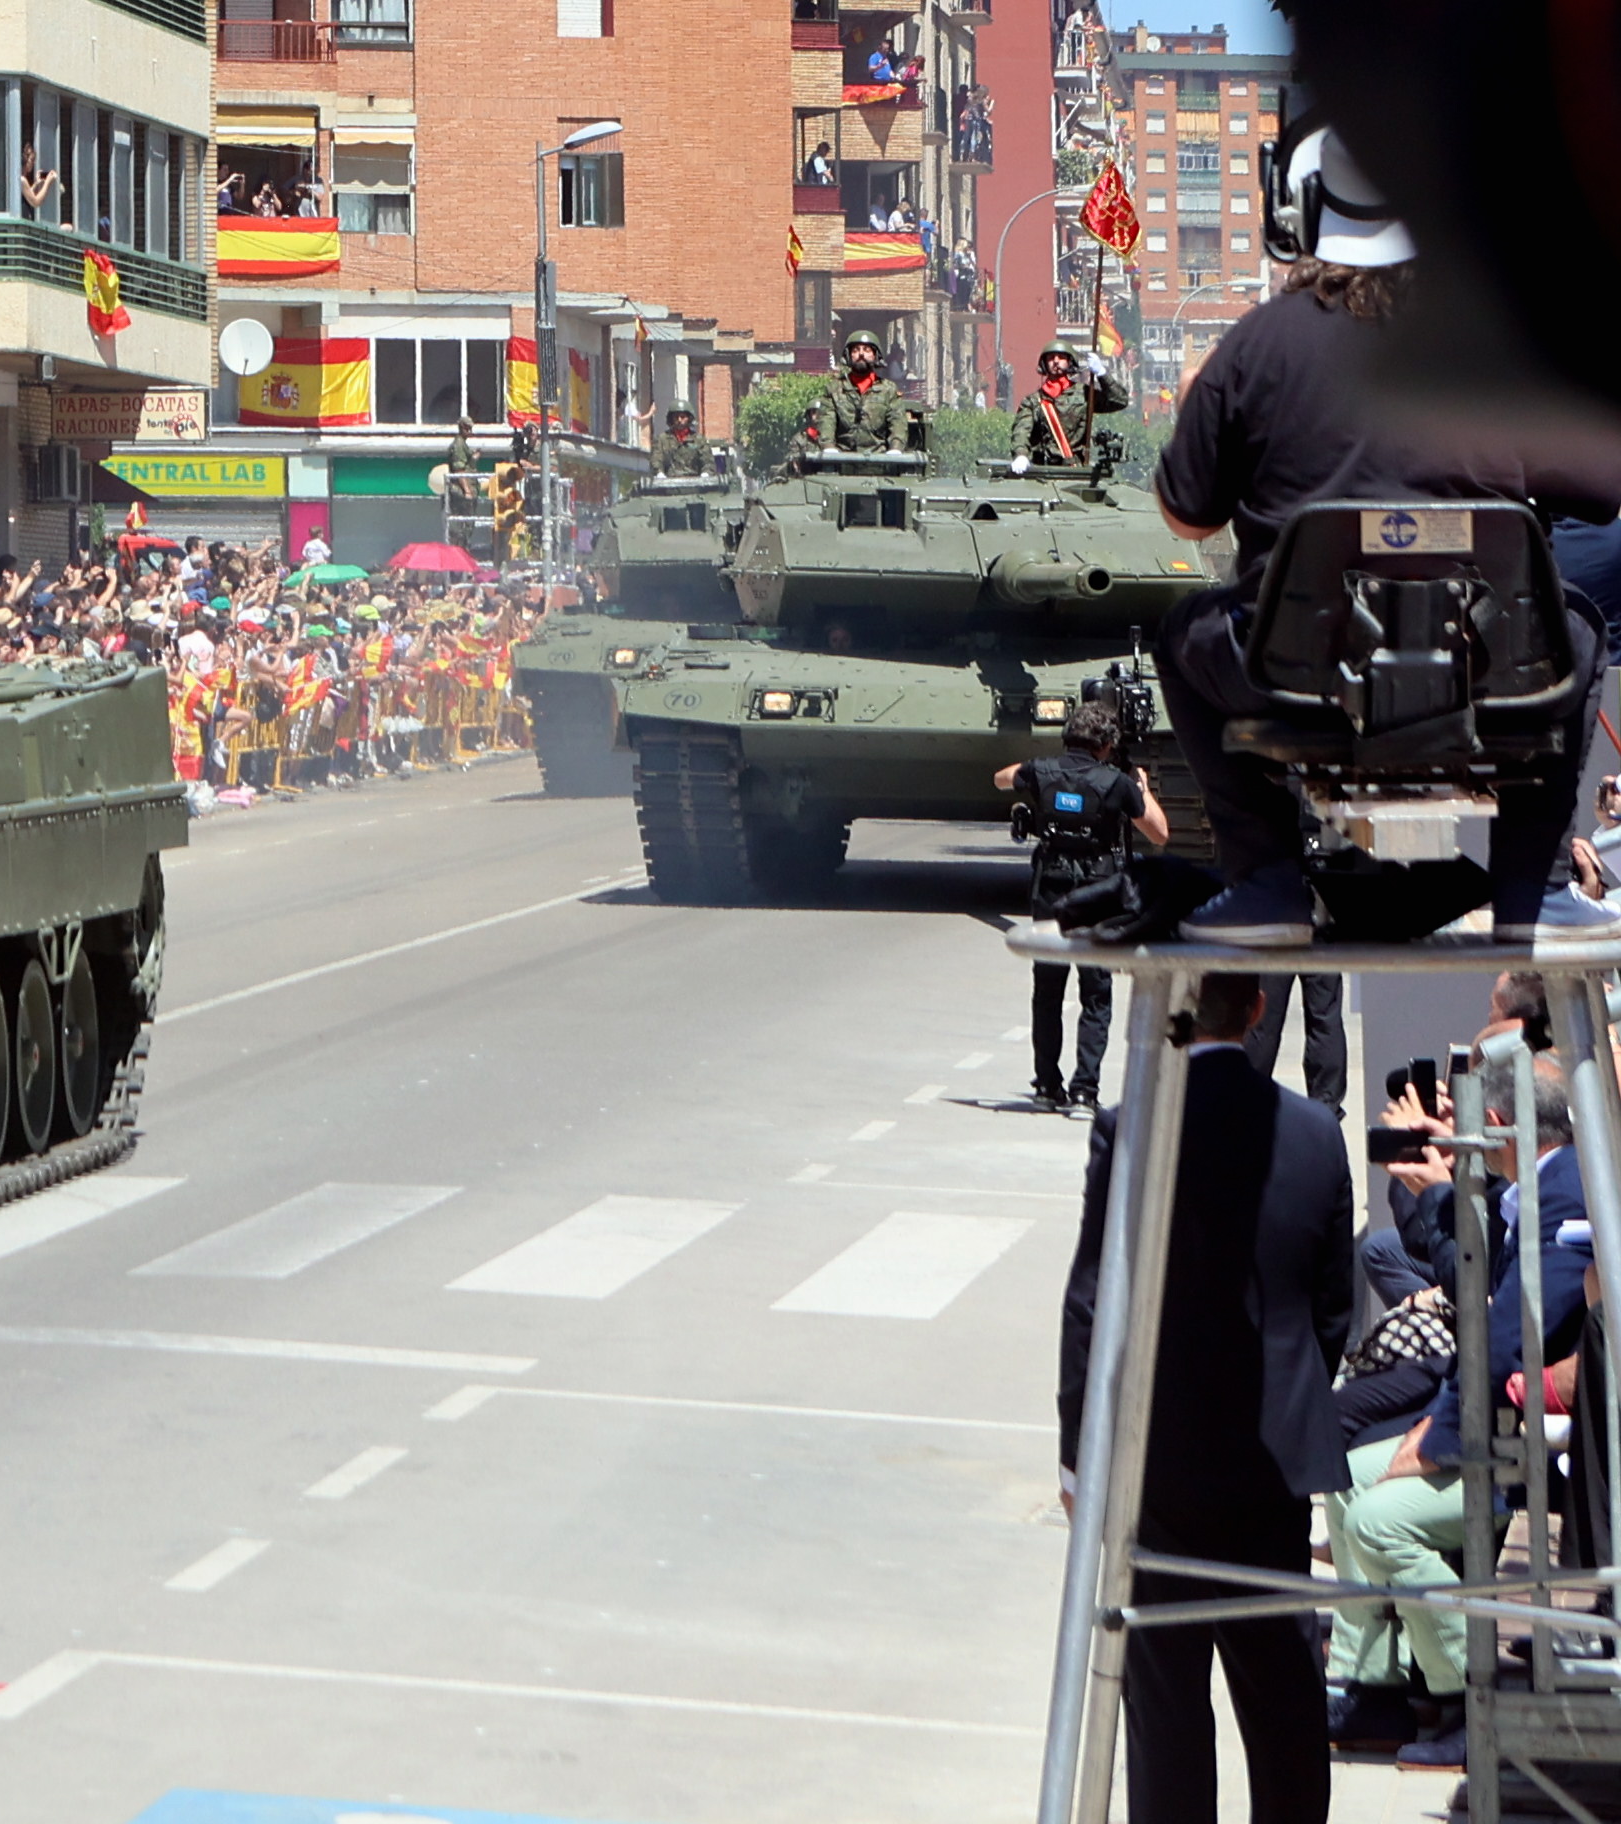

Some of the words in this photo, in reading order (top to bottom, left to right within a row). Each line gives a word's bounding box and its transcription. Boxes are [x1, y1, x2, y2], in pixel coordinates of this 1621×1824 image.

[57, 395, 199, 413] TAPAS-BOCATAS
[56, 418, 141, 435] RACIONES
[220, 463, 266, 482] LAB
[670, 694, 697, 707] 70
